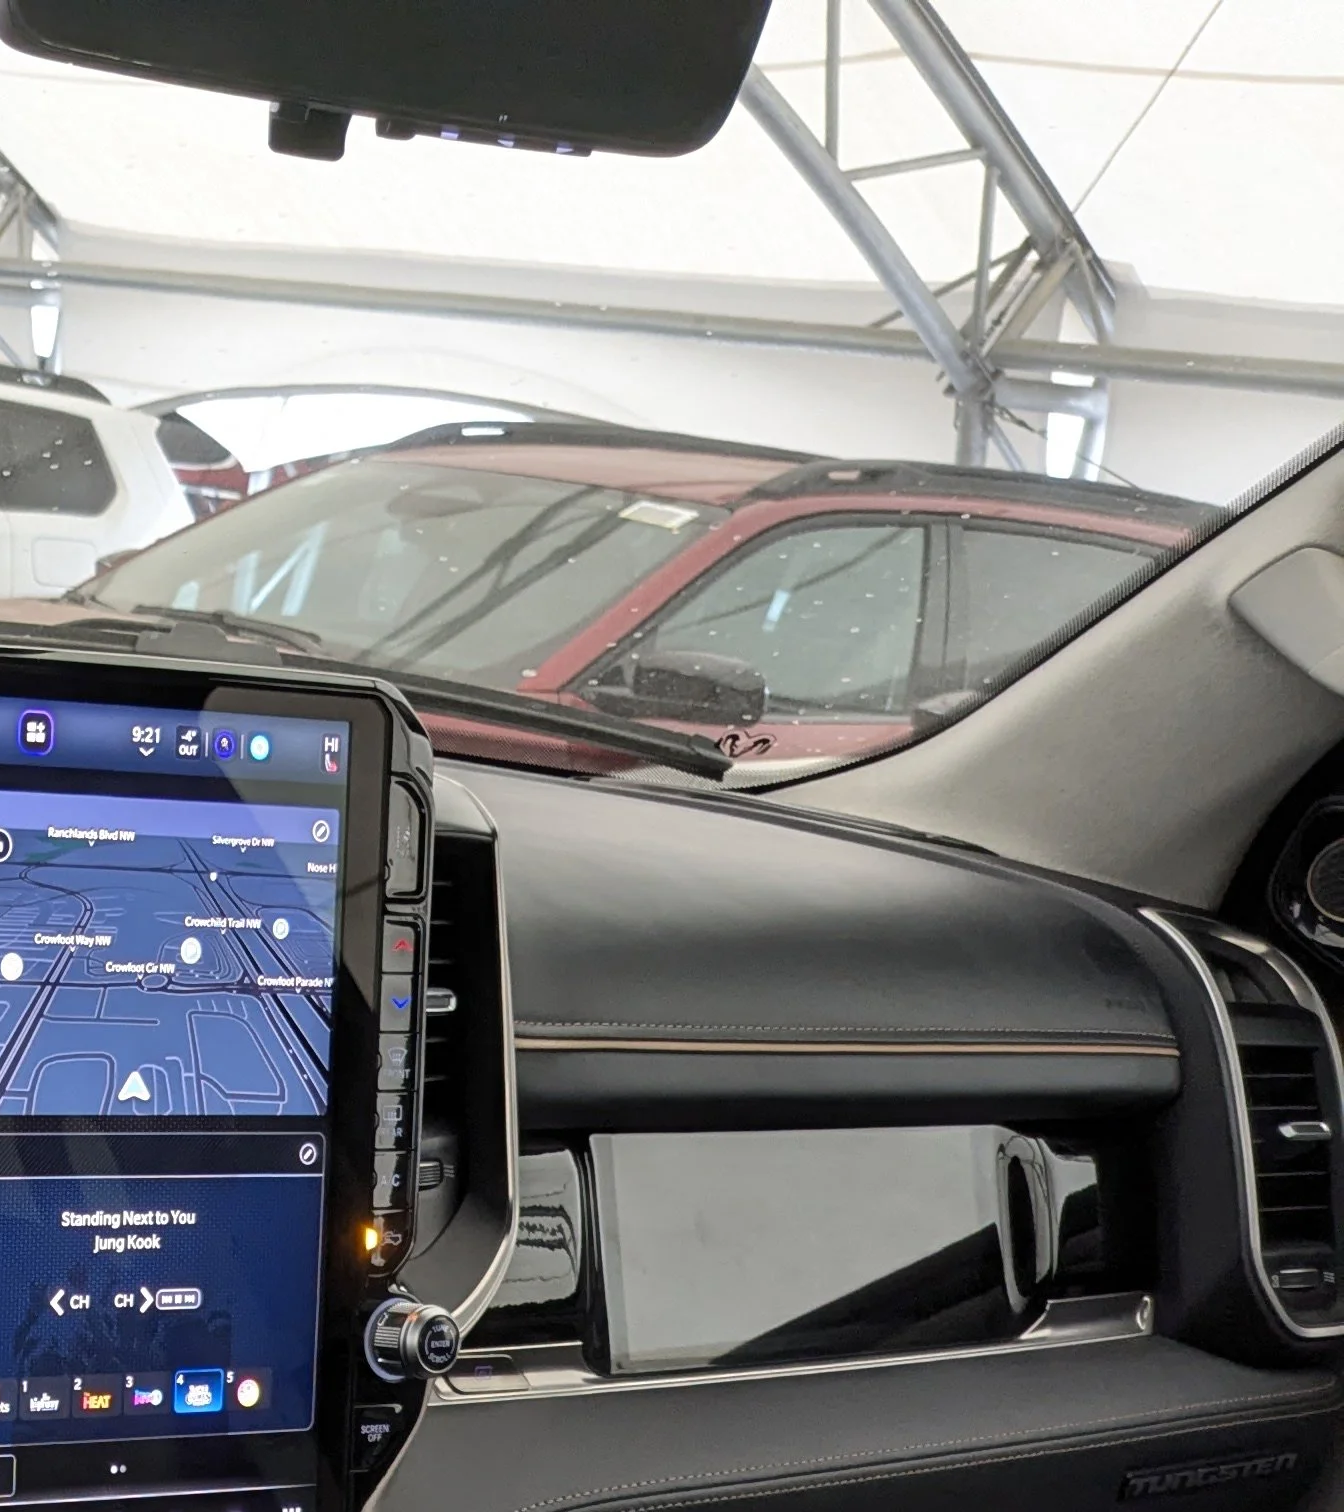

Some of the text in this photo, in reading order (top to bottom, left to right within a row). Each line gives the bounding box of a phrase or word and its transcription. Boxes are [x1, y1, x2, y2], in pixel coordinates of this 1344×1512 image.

[132, 726, 160, 743] 9:21
[178, 744, 198, 756] OUT
[324, 737, 339, 752] HI
[47, 827, 135, 842] Ranchlands Blvd NW
[212, 836, 252, 848] Silvergrove
[262, 838, 275, 847] NW
[307, 862, 328, 873] Nose
[184, 916, 261, 929] Crowchild Trail NW
[34, 933, 111, 947] Crowfoot Way NW
[105, 962, 175, 974] Crowfoot Cir NW
[257, 975, 295, 987] Crowfoot
[295, 976, 323, 987] Parade
[61, 1210, 197, 1229] Standing Next to You
[93, 1234, 161, 1253] Jung Kook
[70, 1295, 90, 1309] CH
[114, 1294, 134, 1308] CH
[430, 1340, 451, 1348] ENTER
[125, 1375, 133, 1388] 3
[176, 1374, 184, 1385] 4
[226, 1371, 234, 1383] 5
[73, 1378, 82, 1390] 2
[360, 1424, 390, 1434] SCREEN
[367, 1434, 382, 1442] OFF
[1127, 1453, 1298, 1497] TUNGSTEN
